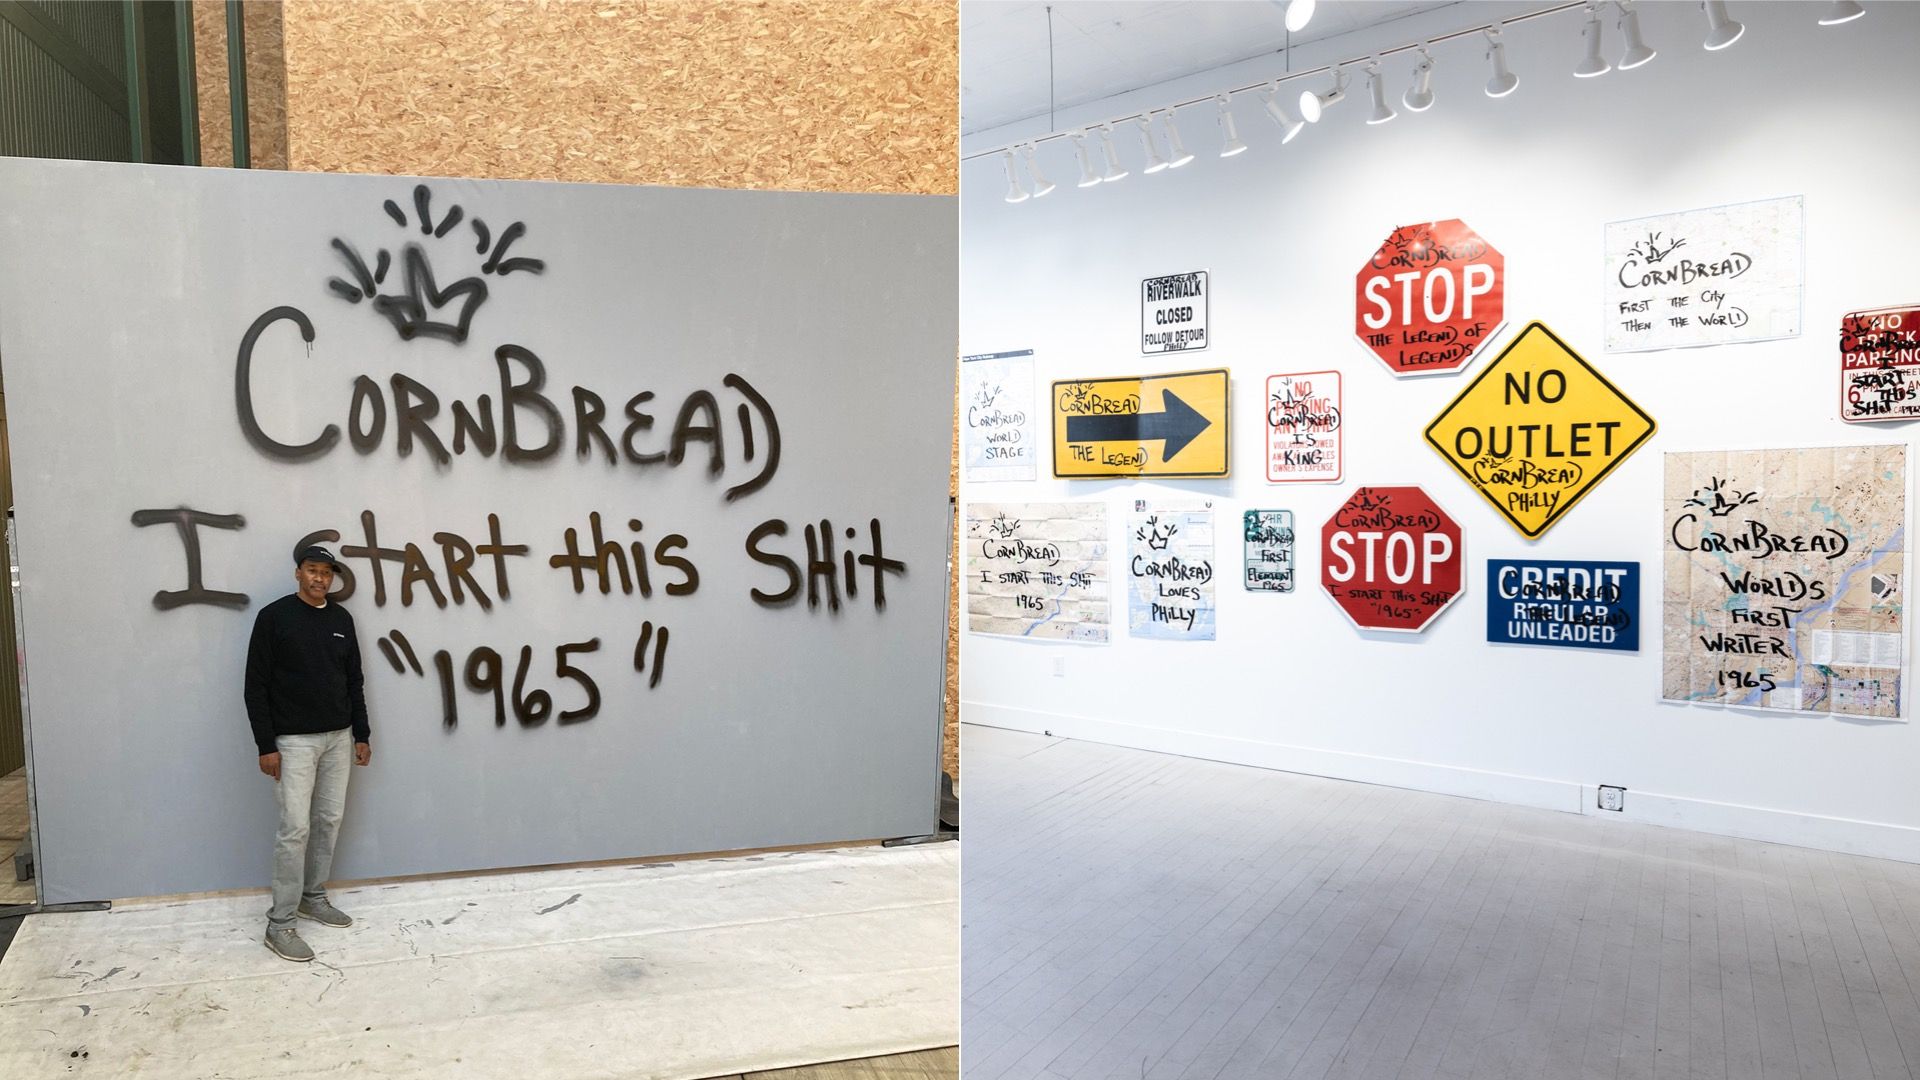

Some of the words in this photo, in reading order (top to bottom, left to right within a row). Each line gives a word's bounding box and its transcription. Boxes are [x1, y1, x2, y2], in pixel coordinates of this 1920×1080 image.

[1146, 279, 1202, 303] RIVERWALK
[1363, 263, 1496, 329] STOP
[1667, 296, 1690, 307] THE
[1156, 306, 1193, 325] CLOSED
[1621, 318, 1652, 332] THEN
[1668, 317, 1690, 327] THE
[1698, 306, 1748, 328] WORLD
[1871, 314, 1902, 330] NO
[1145, 331, 1173, 346] FOLLOW
[1175, 328, 1204, 343] DETOUR
[1367, 333, 1394, 347] THE
[1403, 325, 1458, 346] LEGEND
[1464, 322, 1488, 337] OF
[1400, 342, 1474, 366] LEGENDS
[1294, 381, 1312, 398] NO
[1504, 369, 1567, 405] NO
[1848, 384, 1861, 404] 6
[986, 429, 1022, 444] WORLD
[1292, 433, 1317, 447] IS
[1455, 421, 1621, 460] OUTLET
[985, 447, 1024, 460] STAGE
[1069, 445, 1095, 461] THE
[1102, 446, 1149, 467] LEGEND
[131, 507, 248, 611] I
[1328, 531, 1453, 584] STOP
[980, 570, 993, 583] I
[999, 569, 1032, 585] START
[1498, 565, 1627, 603] CREDIT
[1159, 583, 1201, 601] LOVES
[1328, 584, 1343, 598] I
[1016, 594, 1044, 611] 1965
[1508, 620, 1616, 643] UNLEADED
[1718, 670, 1777, 692] 1965
